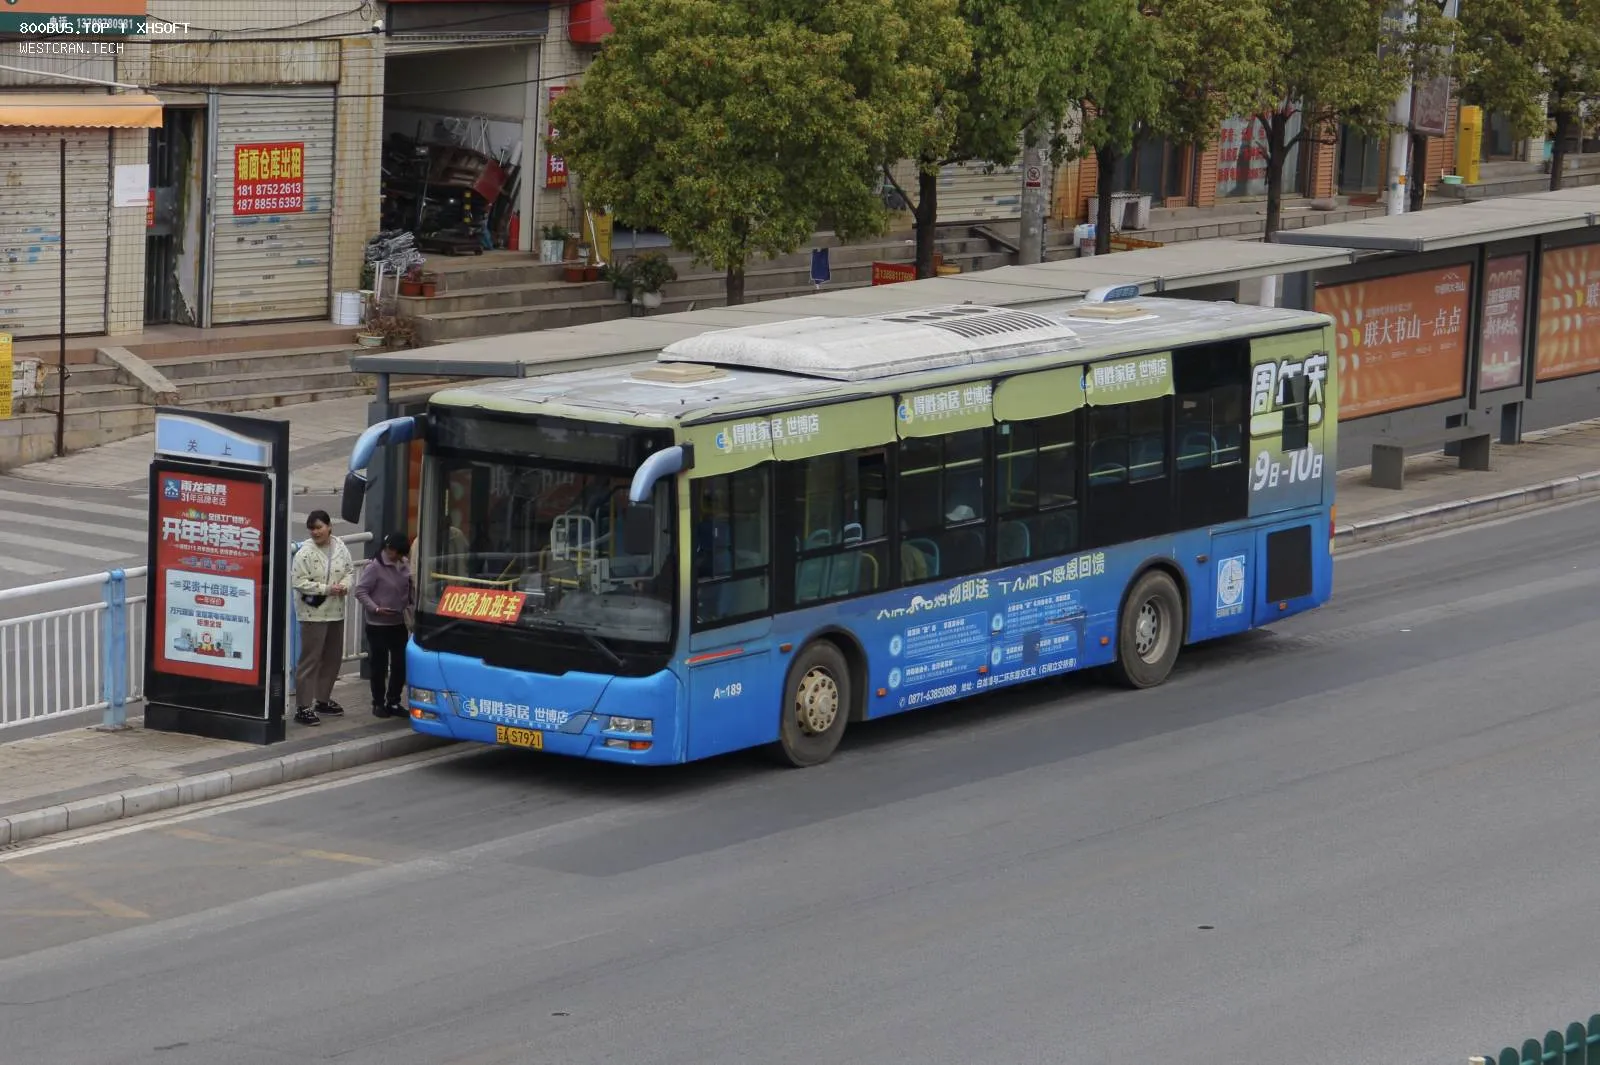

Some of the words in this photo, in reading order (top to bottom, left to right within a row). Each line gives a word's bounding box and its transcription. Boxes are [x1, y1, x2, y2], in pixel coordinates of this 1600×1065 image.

[238, 147, 301, 180] 铺面仓库出租
[237, 184, 253, 196] 181
[256, 183, 278, 195] 8752
[280, 182, 301, 194] 2613
[237, 199, 253, 210] 187
[254, 197, 277, 209] 8855
[278, 196, 301, 208] 6392
[1363, 305, 1462, 348] 联大书山一点点
[1094, 362, 1136, 387] 得胜家居
[1139, 358, 1168, 378] 世博店
[913, 389, 961, 415] 得胜家居
[963, 384, 992, 406] 世博店
[732, 418, 784, 445] 得胜家居
[786, 413, 819, 436] 世博店
[162, 517, 261, 552] 开年特卖会
[441, 591, 521, 620] 108路加班车
[713, 682, 742, 700] A-189
[479, 699, 530, 720] 得胜家居
[534, 707, 569, 724] 世博店
